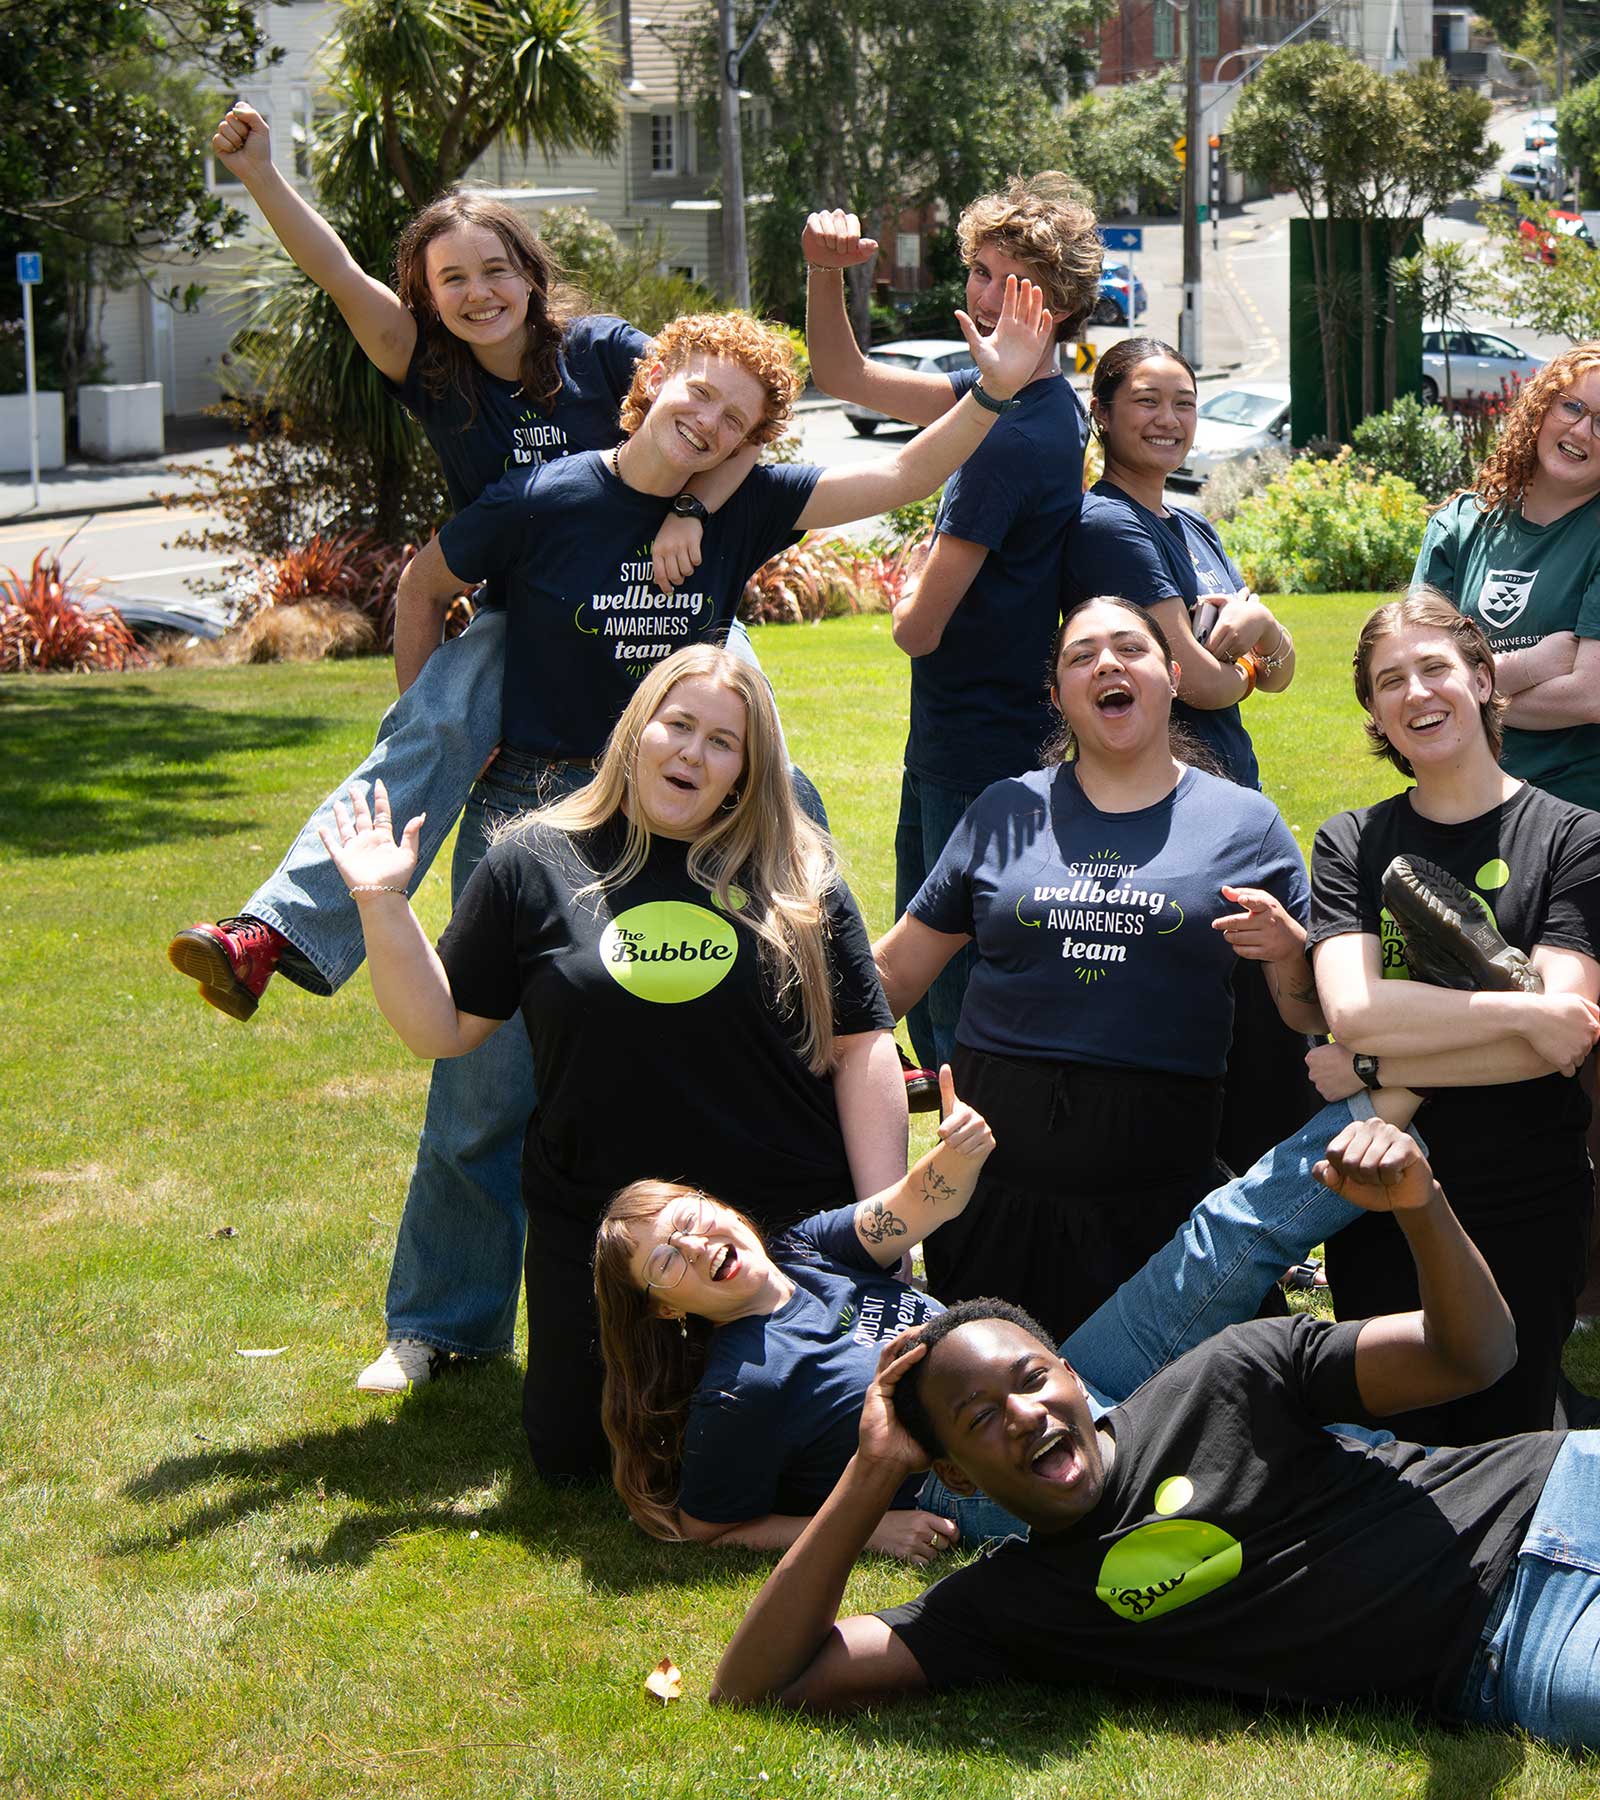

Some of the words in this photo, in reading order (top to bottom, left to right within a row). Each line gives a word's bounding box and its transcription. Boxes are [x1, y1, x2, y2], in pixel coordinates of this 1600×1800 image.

[620, 562, 654, 582] STUD
[1505, 575, 1521, 583] 1897
[592, 585, 704, 615] wellbeing
[604, 616, 689, 636] AWARENESS
[615, 641, 672, 660] team
[1068, 863, 1137, 879] STUDENT
[1033, 880, 1166, 915] wellbeing
[1047, 908, 1145, 936] AWARENESS
[1384, 920, 1403, 937] Th
[614, 929, 646, 941] The
[612, 939, 733, 963] Bubble
[1062, 936, 1127, 962] team
[879, 1292, 924, 1343] being
